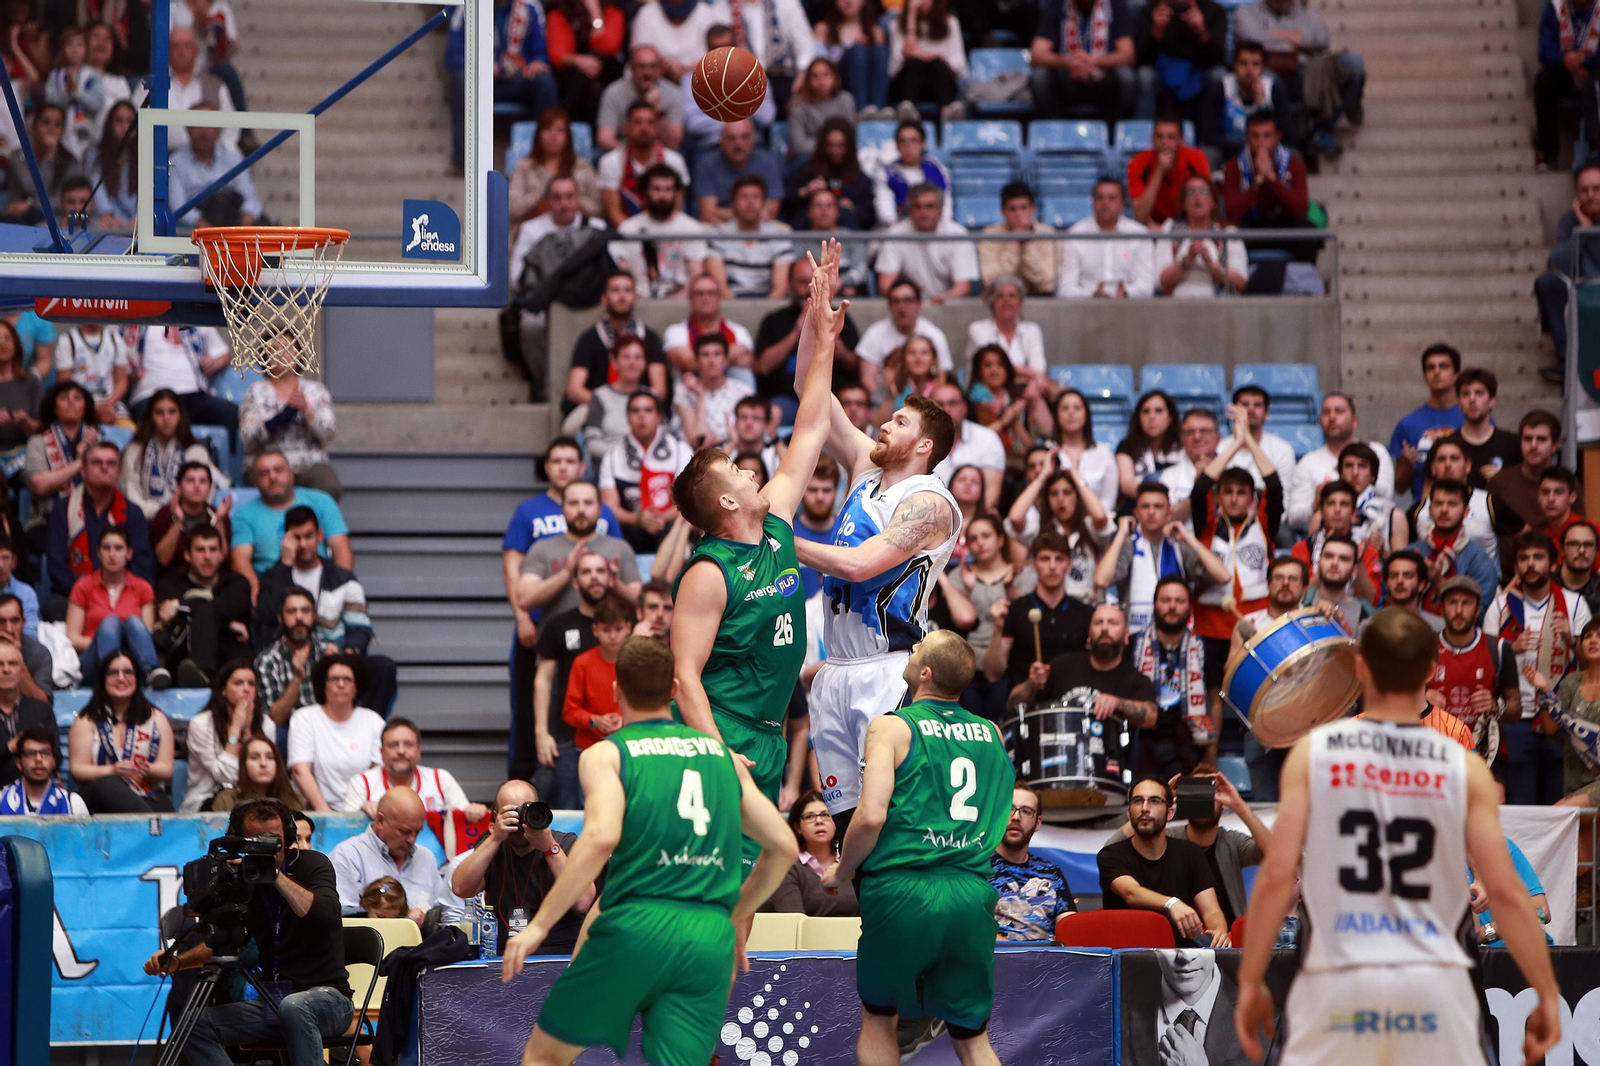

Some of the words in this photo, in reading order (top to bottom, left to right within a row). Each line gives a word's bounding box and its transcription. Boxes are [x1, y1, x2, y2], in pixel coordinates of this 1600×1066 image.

[420, 240, 455, 252] endesa
[421, 224, 440, 243] liga
[831, 583, 852, 615] 21
[773, 612, 794, 647] 26
[917, 719, 993, 743] DEVRIES
[676, 768, 711, 837] 4
[949, 756, 979, 822] 2
[1338, 808, 1436, 901] 32
